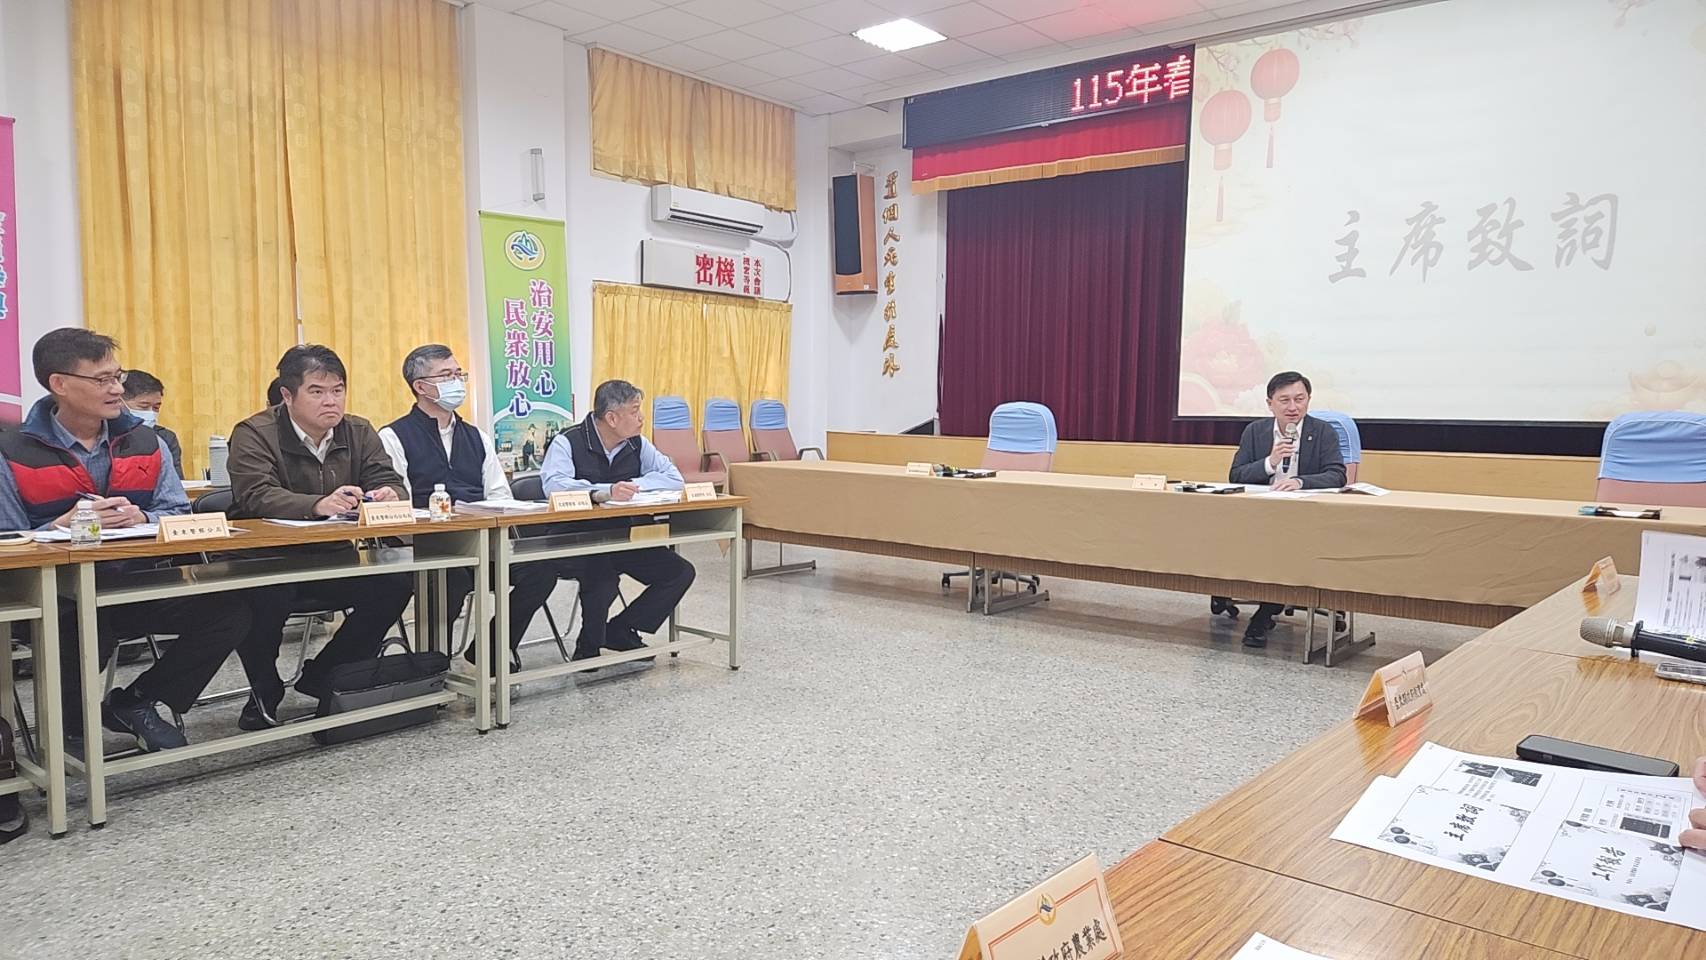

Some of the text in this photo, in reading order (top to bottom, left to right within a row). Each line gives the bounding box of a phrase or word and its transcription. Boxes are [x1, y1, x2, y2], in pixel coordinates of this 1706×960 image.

[1328, 192, 1619, 284] 主席致詞
[530, 279, 556, 397] 治安用心
